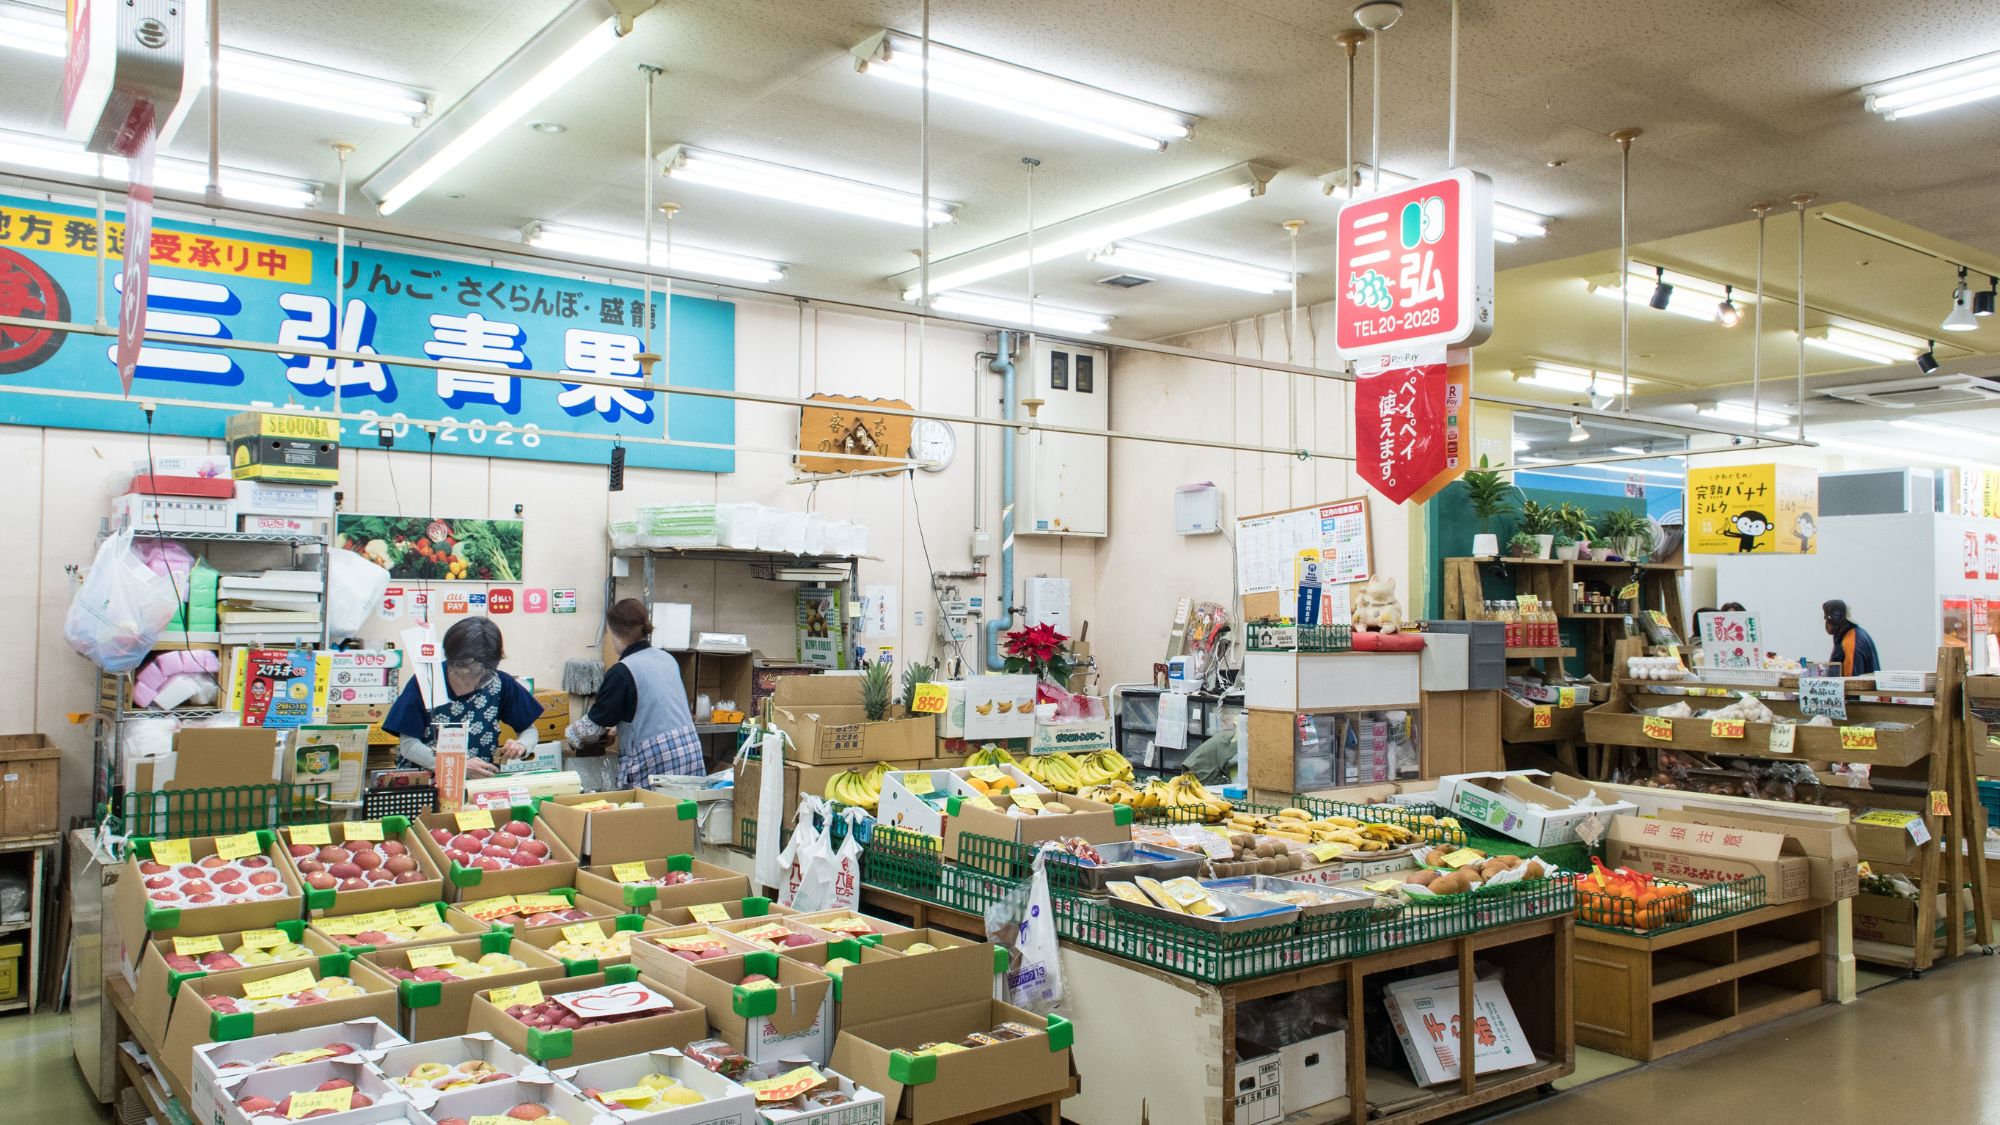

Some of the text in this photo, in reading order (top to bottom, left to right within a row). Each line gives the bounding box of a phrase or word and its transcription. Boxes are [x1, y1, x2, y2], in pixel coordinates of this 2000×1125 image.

[1350, 211, 1391, 268] 三
[1399, 250, 1444, 308] 弘
[107, 272, 655, 424] 三弘青果
[1696, 482, 1768, 501] 完熟バナナ
[1697, 501, 1728, 514] ミルク
[804, 640, 832, 651] KIWI FRUIT
[916, 696, 945, 711] 850
[1643, 823, 1745, 847] 取扱注意
[1034, 966, 1046, 977] 13
[759, 1078, 815, 1100] 780
